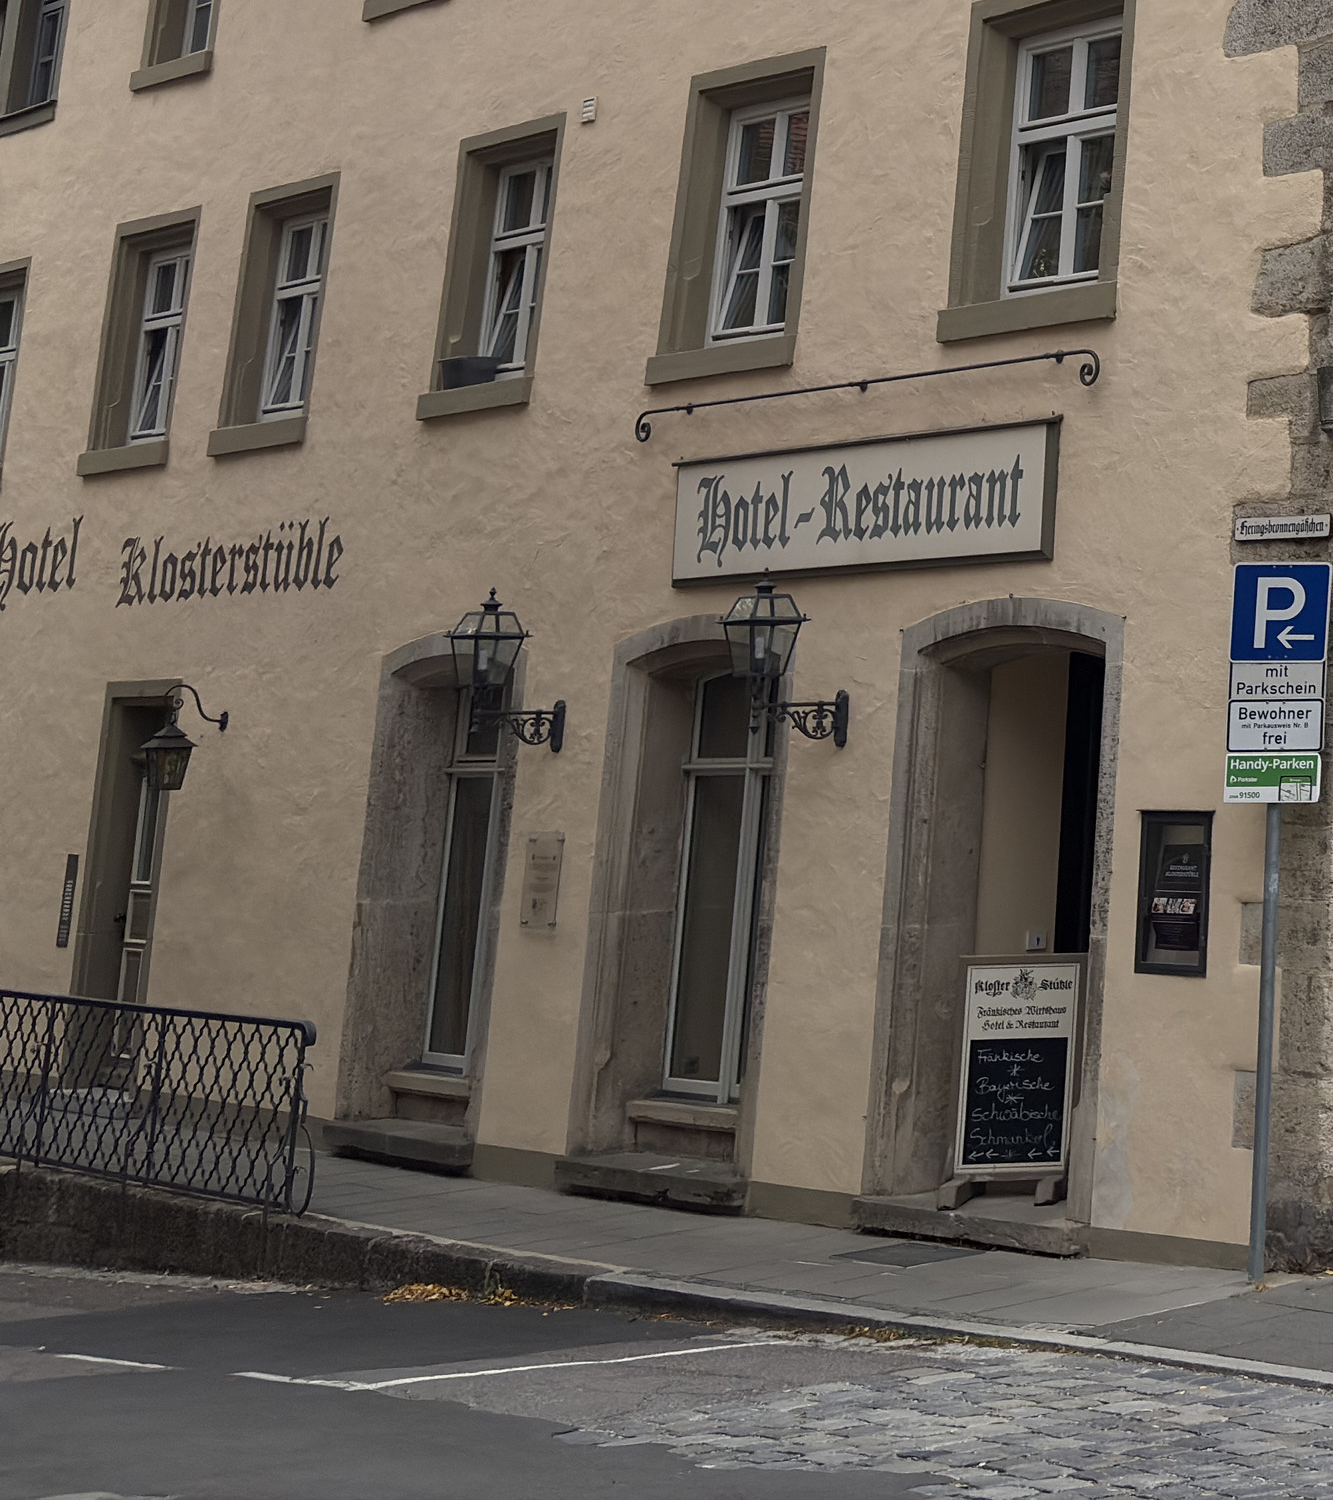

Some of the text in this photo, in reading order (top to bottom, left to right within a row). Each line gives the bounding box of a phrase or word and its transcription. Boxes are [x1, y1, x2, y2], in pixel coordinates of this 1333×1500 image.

[115, 516, 344, 608] Klosterstüble
[1253, 577, 1306, 648] P
[1265, 664, 1288, 677] mit
[1236, 681, 1316, 694] Parkschein
[1238, 707, 1312, 720] Bewohner
[1262, 731, 1287, 745] frei
[1230, 758, 1314, 772] Handy-Parken
[1239, 791, 1260, 799] 91500
[977, 1006, 1023, 1019] Fränkisches
[981, 1020, 1005, 1031] Hotel
[1015, 1020, 1060, 1029] Restaurant
